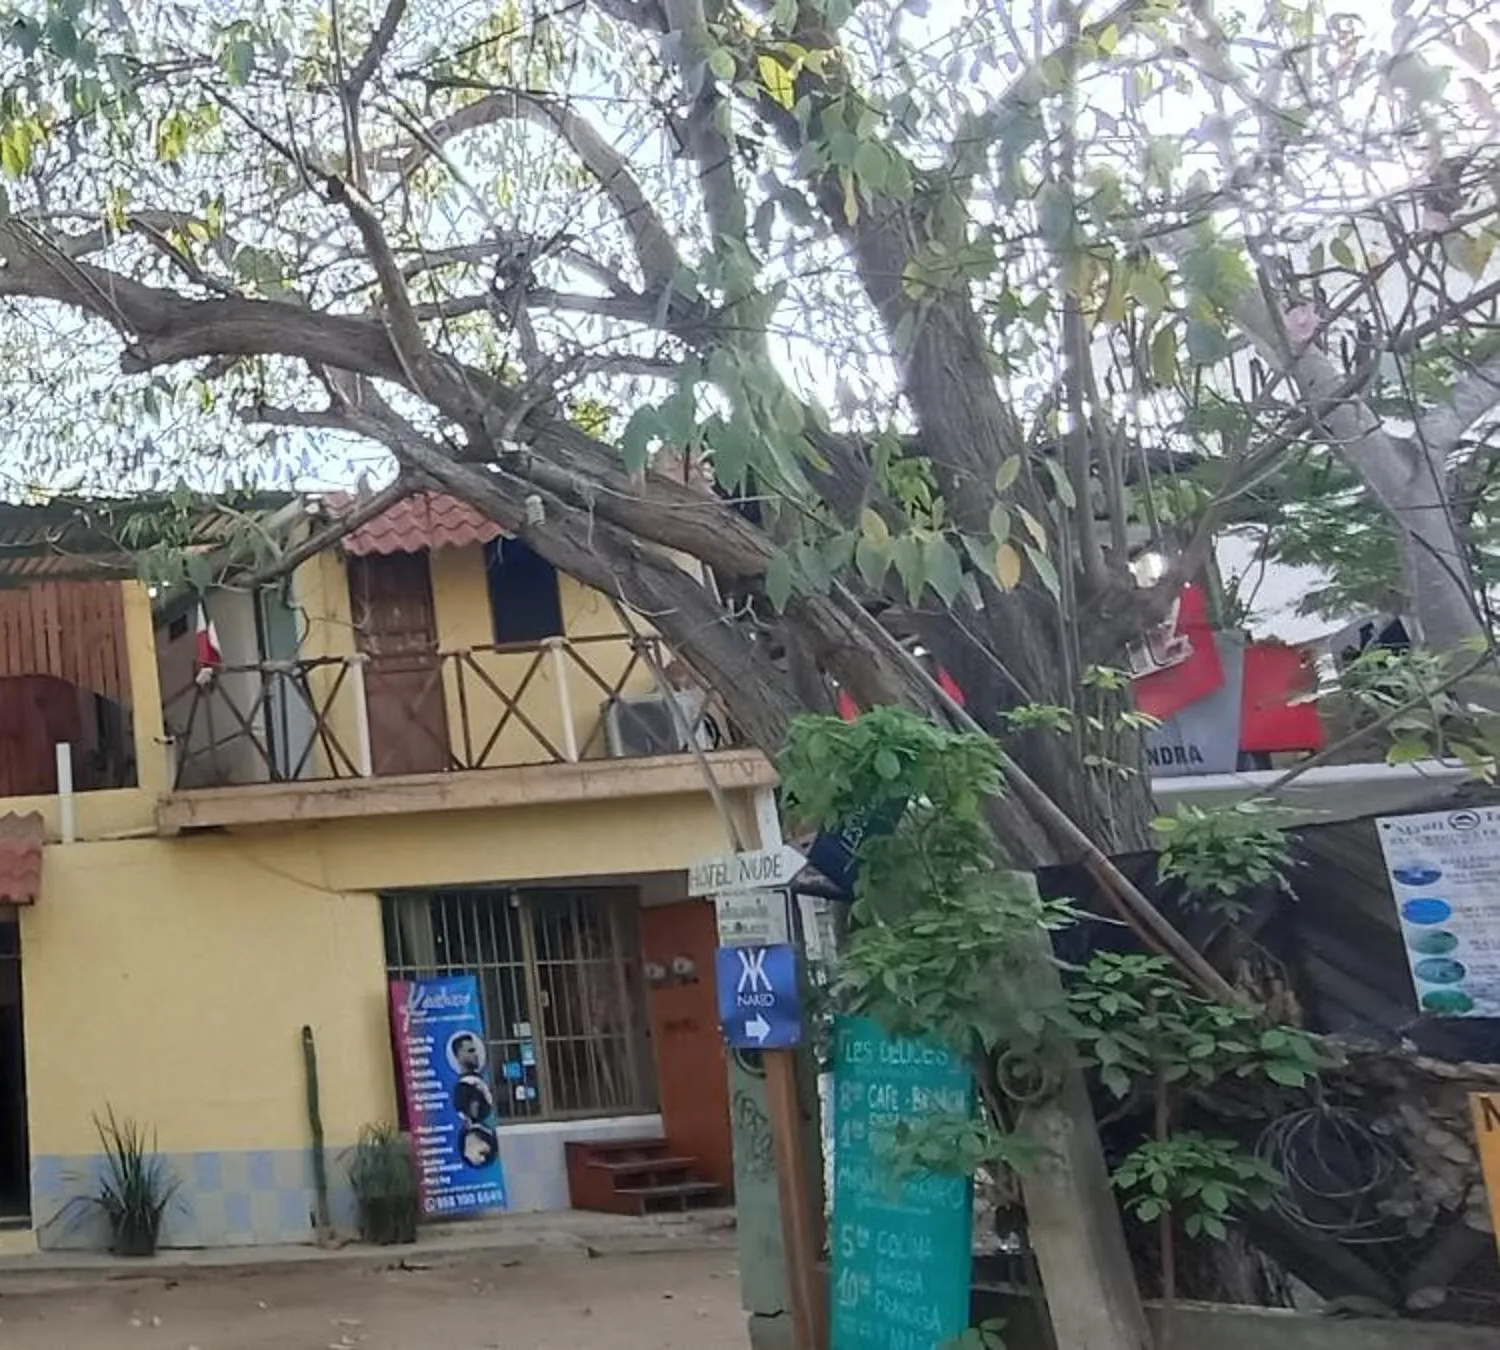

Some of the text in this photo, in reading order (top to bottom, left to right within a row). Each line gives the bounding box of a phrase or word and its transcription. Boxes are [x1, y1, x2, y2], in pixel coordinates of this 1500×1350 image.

[1146, 744, 1204, 767] NDRA
[739, 853, 784, 881] NUDE
[845, 1039, 873, 1063] LES
